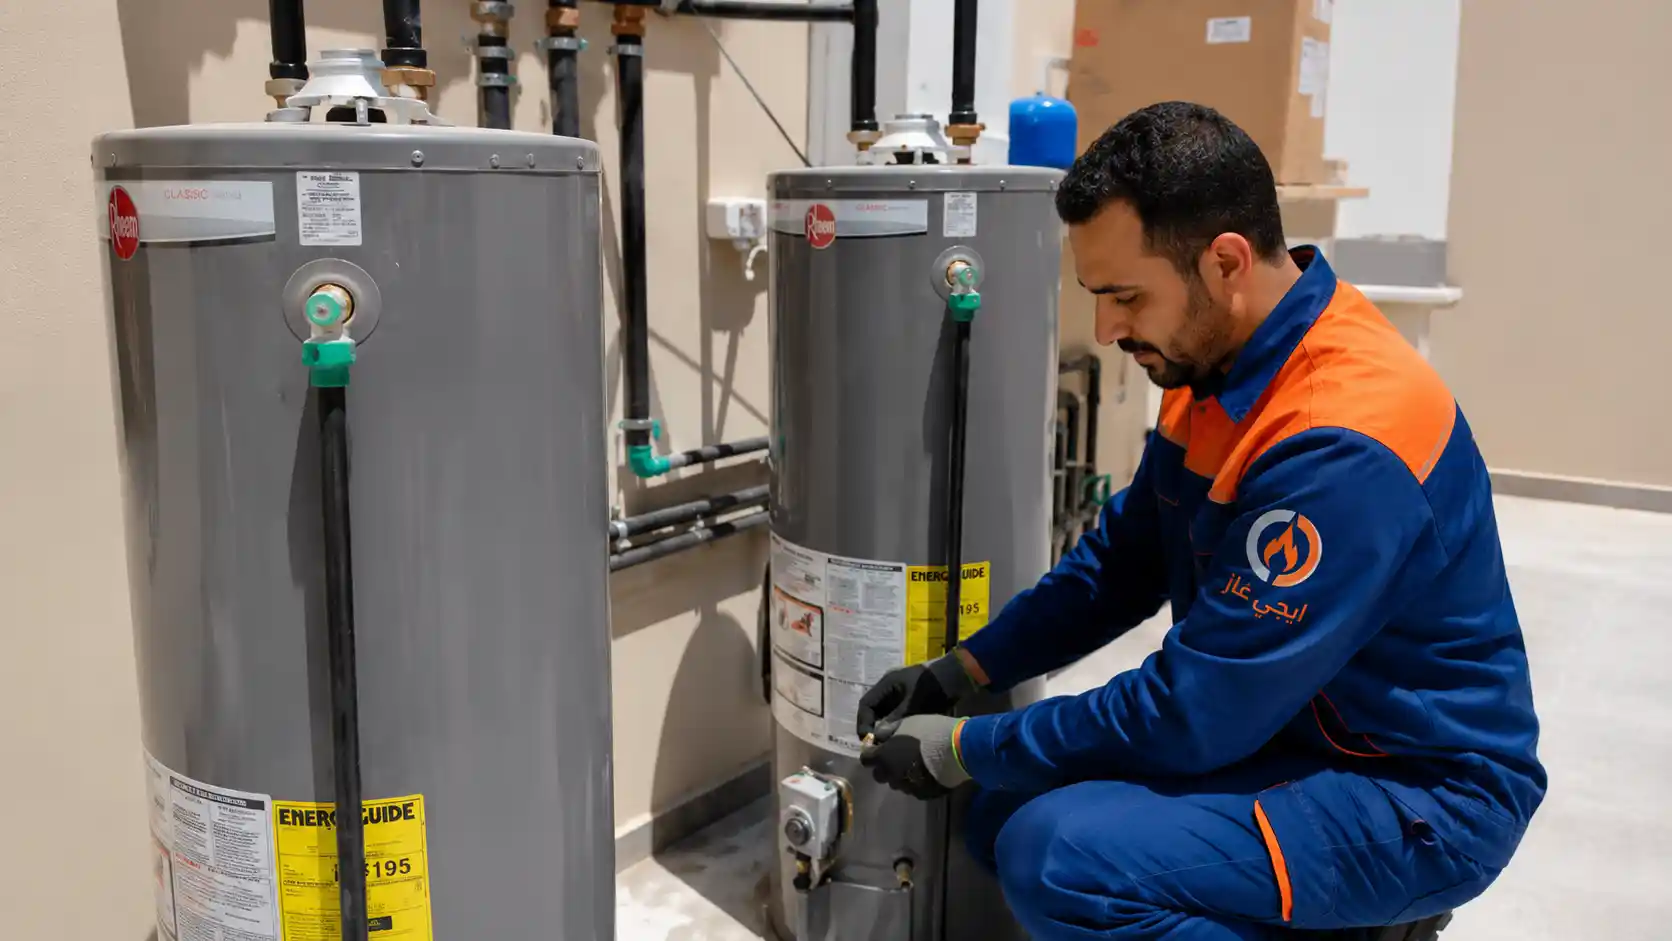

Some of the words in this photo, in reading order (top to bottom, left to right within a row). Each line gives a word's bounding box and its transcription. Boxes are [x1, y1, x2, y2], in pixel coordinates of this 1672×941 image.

[109, 187, 138, 249] Rheem
[962, 567, 985, 580] UIDE
[1220, 572, 1251, 601] غاز
